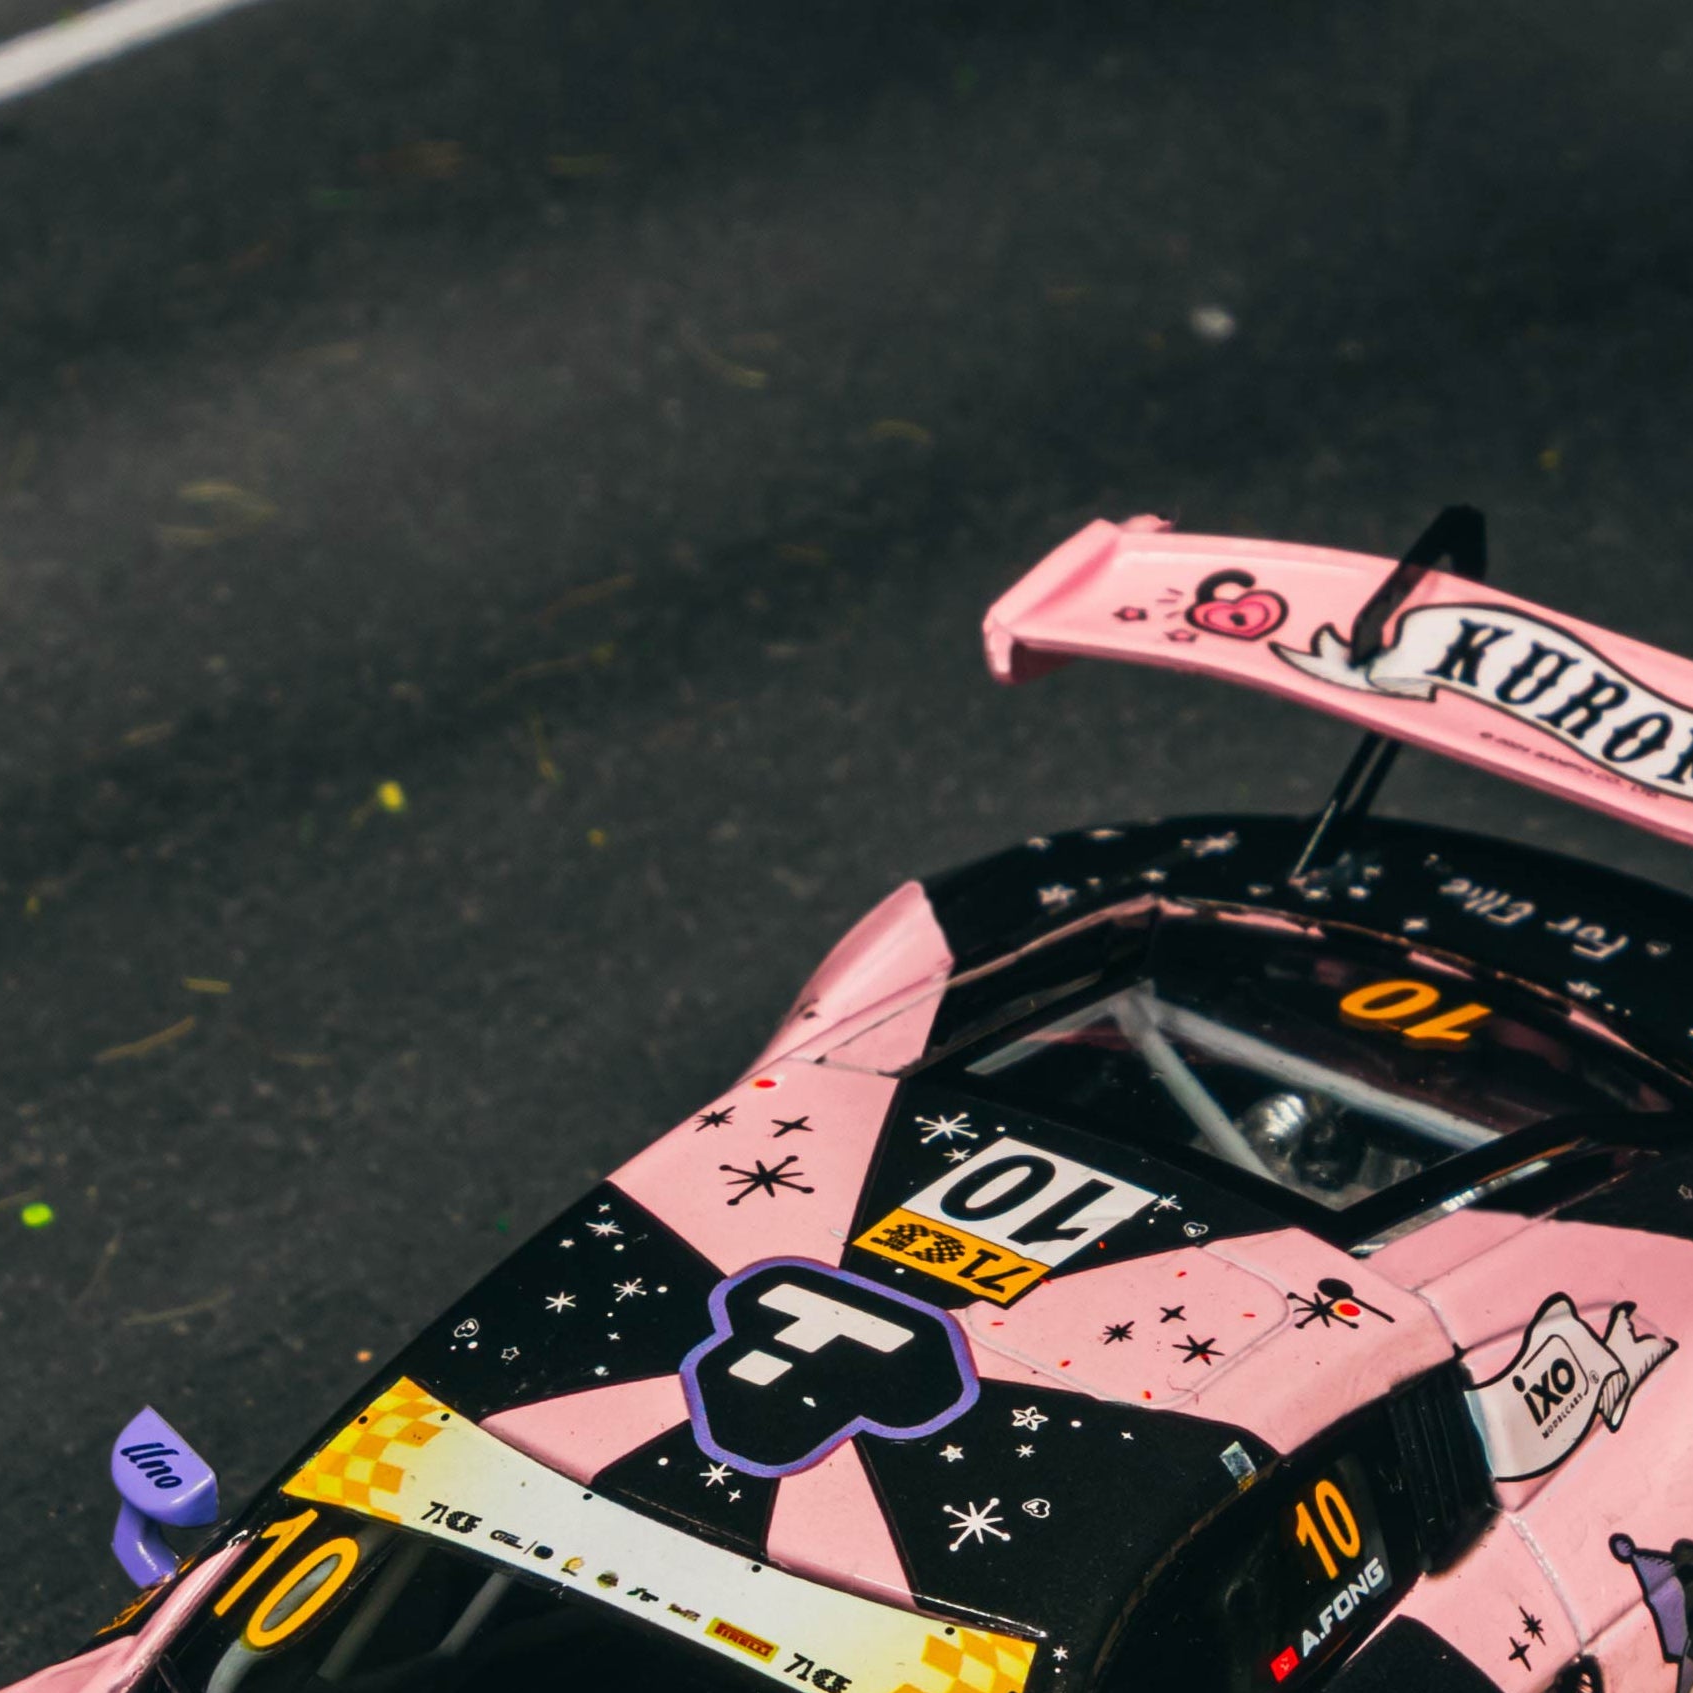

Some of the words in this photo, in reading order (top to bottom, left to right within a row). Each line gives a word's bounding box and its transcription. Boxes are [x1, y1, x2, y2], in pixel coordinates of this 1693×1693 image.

[1545, 916, 1629, 960] For
[1339, 979, 1493, 1042] 10
[940, 1153, 1116, 1247] 10
[212, 1507, 360, 1649] 10
[1295, 1479, 1362, 1581] 10
[1301, 1556, 1386, 1659] A.FONG
